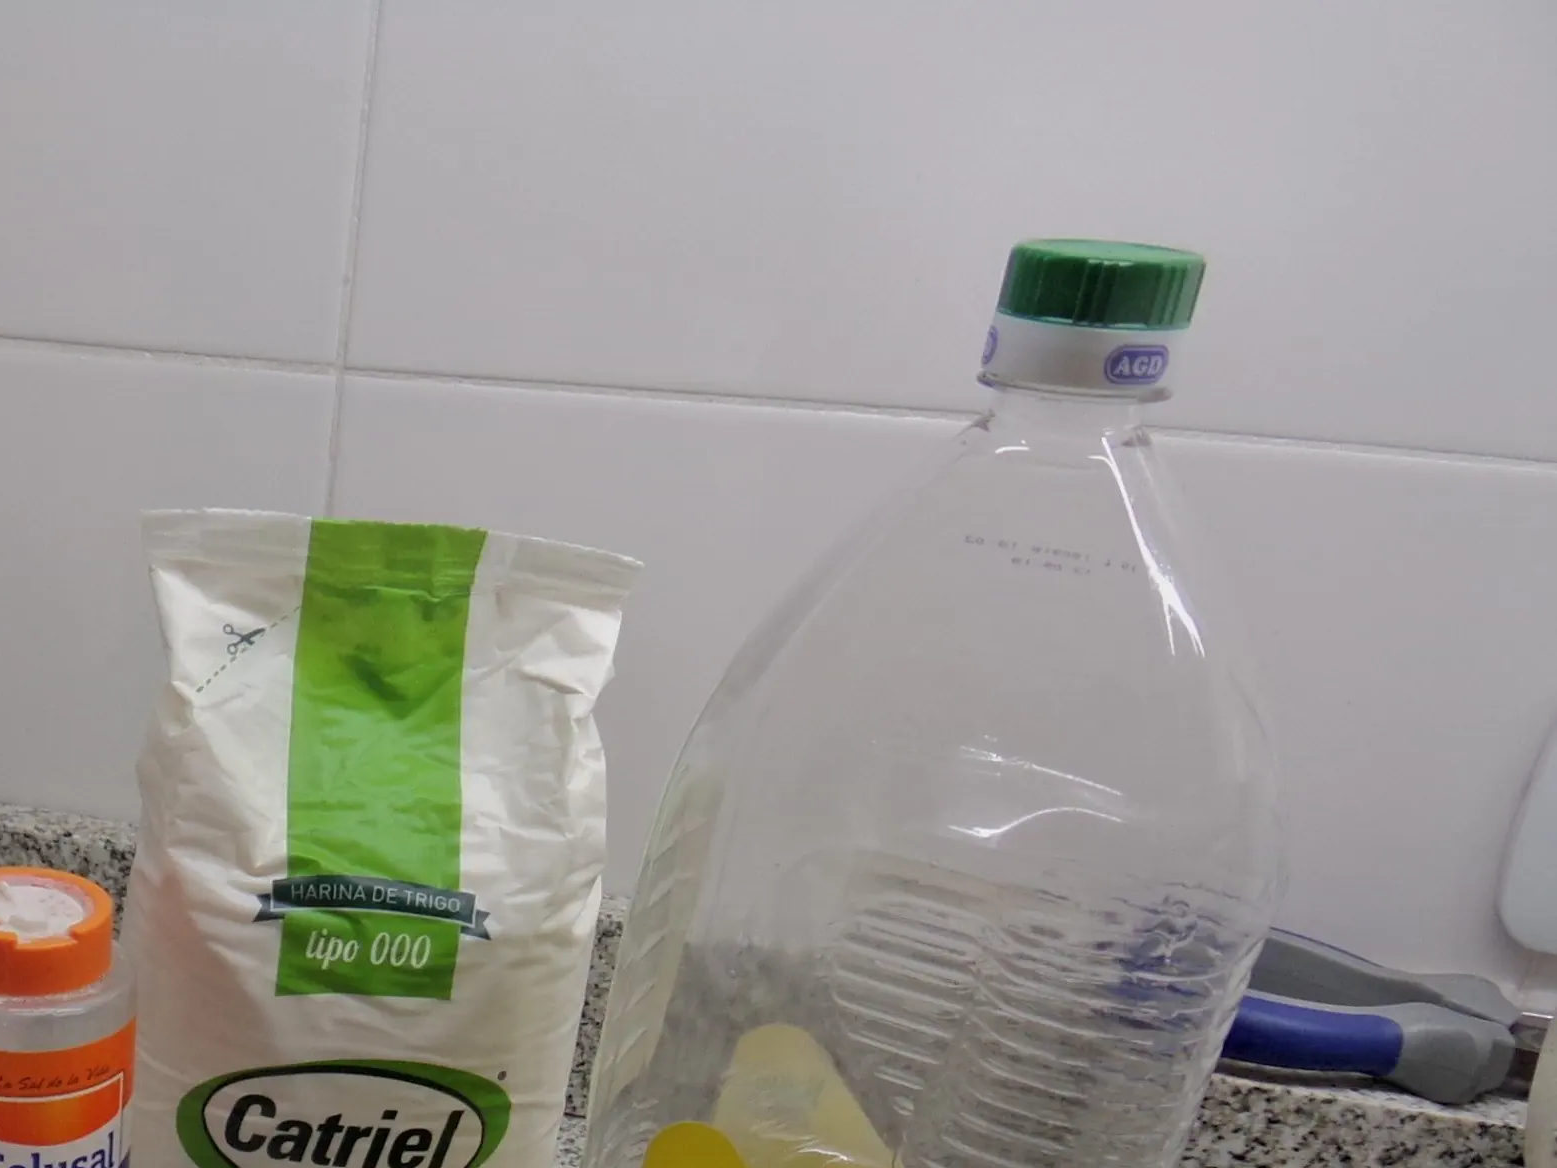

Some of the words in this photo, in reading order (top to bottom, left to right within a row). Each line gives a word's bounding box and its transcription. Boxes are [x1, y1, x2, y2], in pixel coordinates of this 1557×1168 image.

[1112, 352, 1164, 379] AGD
[290, 883, 367, 903] HARINA
[371, 886, 399, 906] DE
[402, 889, 462, 914] TRIGO
[369, 931, 433, 969] 000
